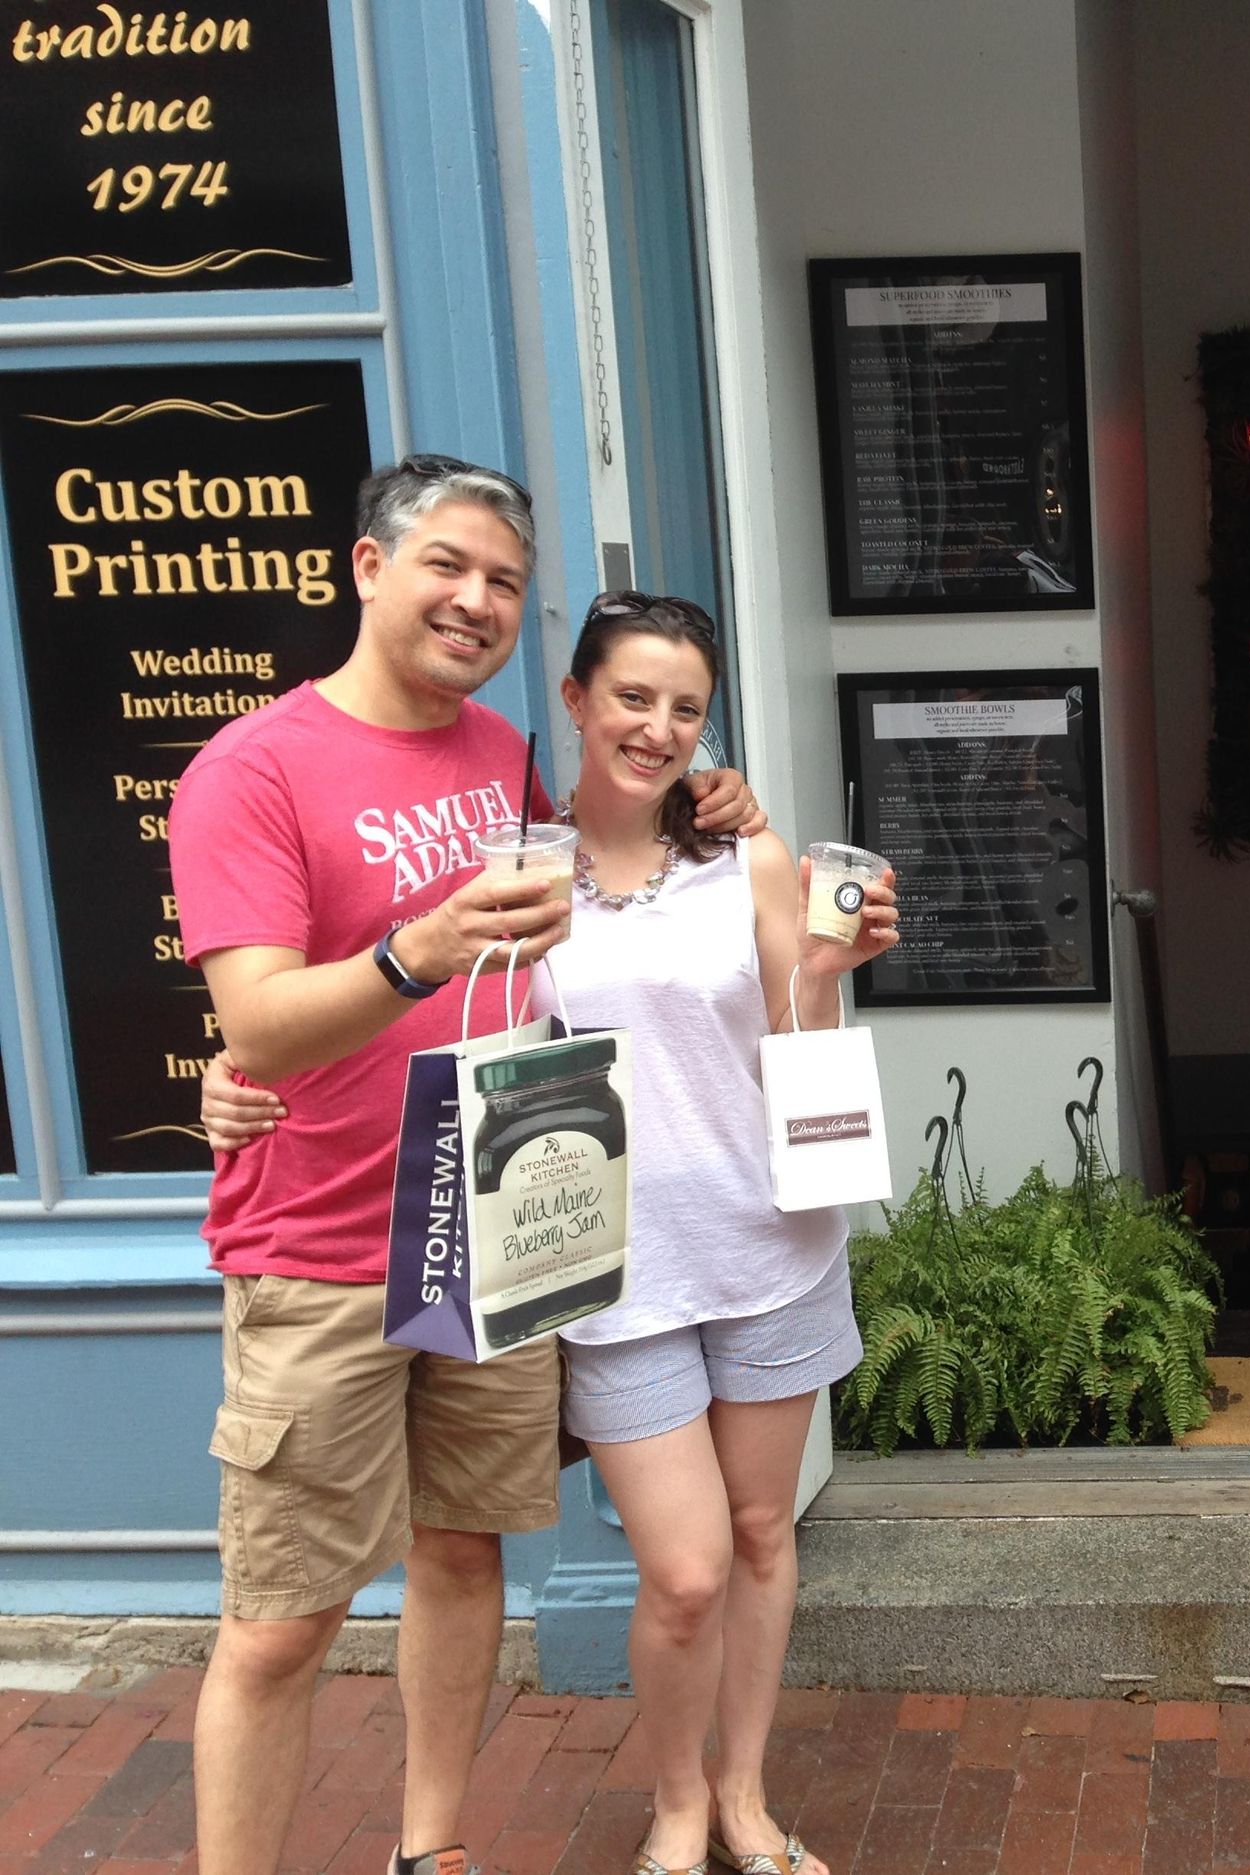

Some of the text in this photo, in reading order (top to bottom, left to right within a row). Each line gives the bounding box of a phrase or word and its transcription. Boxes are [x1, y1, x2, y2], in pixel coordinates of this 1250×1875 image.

[12, 4, 251, 63] tradition
[81, 92, 214, 136] since
[87, 160, 228, 213] 1974
[880, 288, 1012, 302] SUPERFOOD SMOOTHIES
[55, 467, 312, 524] Custom
[48, 537, 337, 606] Printing
[130, 647, 275, 681] Wedding
[925, 704, 1016, 715] SMOOTHIE BOWLS
[354, 780, 522, 864] SAMUEL
[519, 1148, 588, 1174] STONEWALL
[531, 1162, 579, 1183] KITCHEN
[512, 1182, 602, 1228] Wild Maine
[502, 1210, 606, 1261] Blueberry Jam
